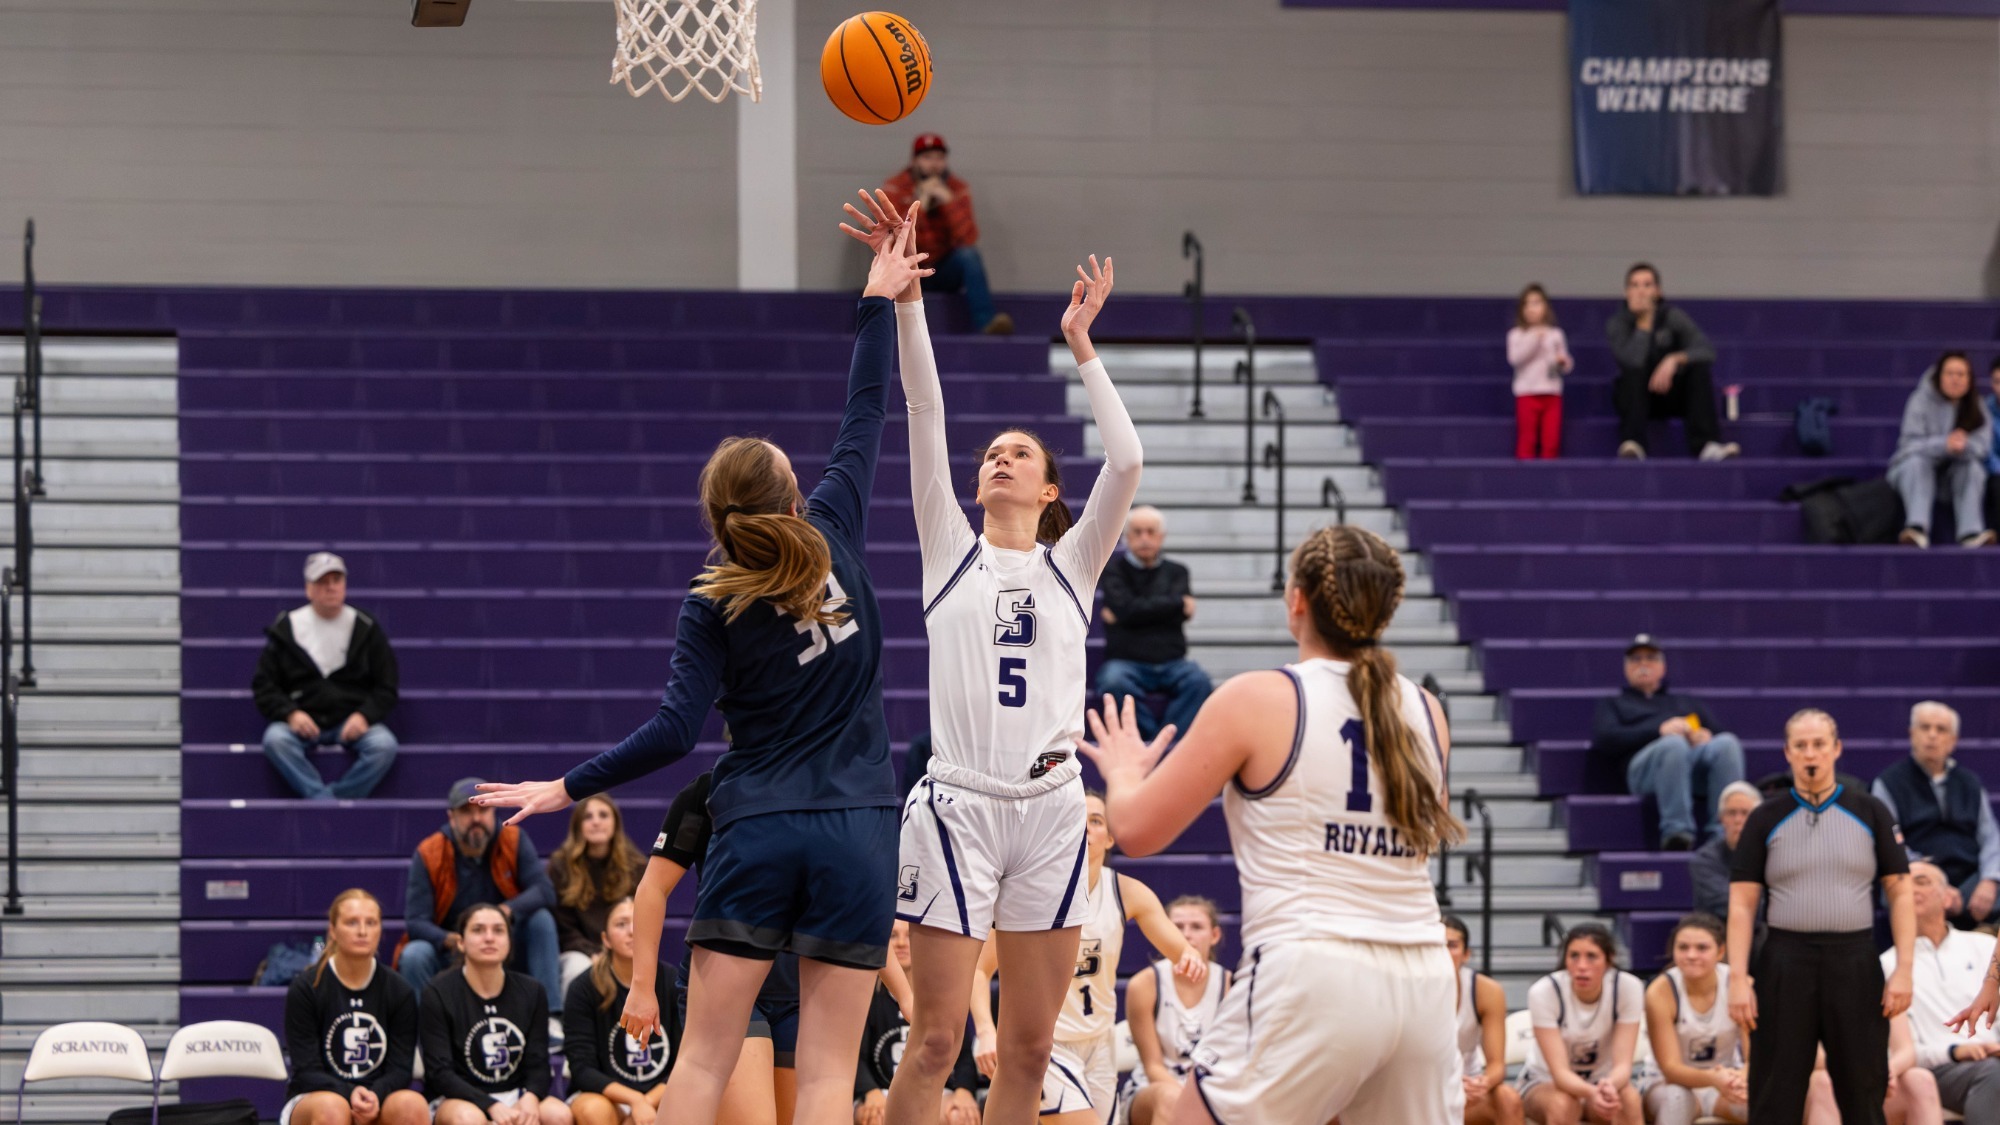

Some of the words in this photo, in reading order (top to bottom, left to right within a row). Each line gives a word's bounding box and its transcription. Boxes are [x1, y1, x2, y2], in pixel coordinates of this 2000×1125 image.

[885, 22, 922, 95] Wilson
[1581, 57, 1770, 86] CHAMPIONS
[1596, 86, 1663, 112] WIN
[1668, 86, 1750, 112] HERE
[994, 588, 1036, 647] S
[998, 657, 1027, 708] 5
[1339, 718, 1372, 812] 1
[897, 864, 920, 902] S
[1079, 985, 1094, 1016] 1
[51, 1040, 128, 1055] SCRANTON
[185, 1039, 262, 1055] SCRANTON
[344, 1027, 370, 1064] S
[482, 1032, 510, 1069] S
